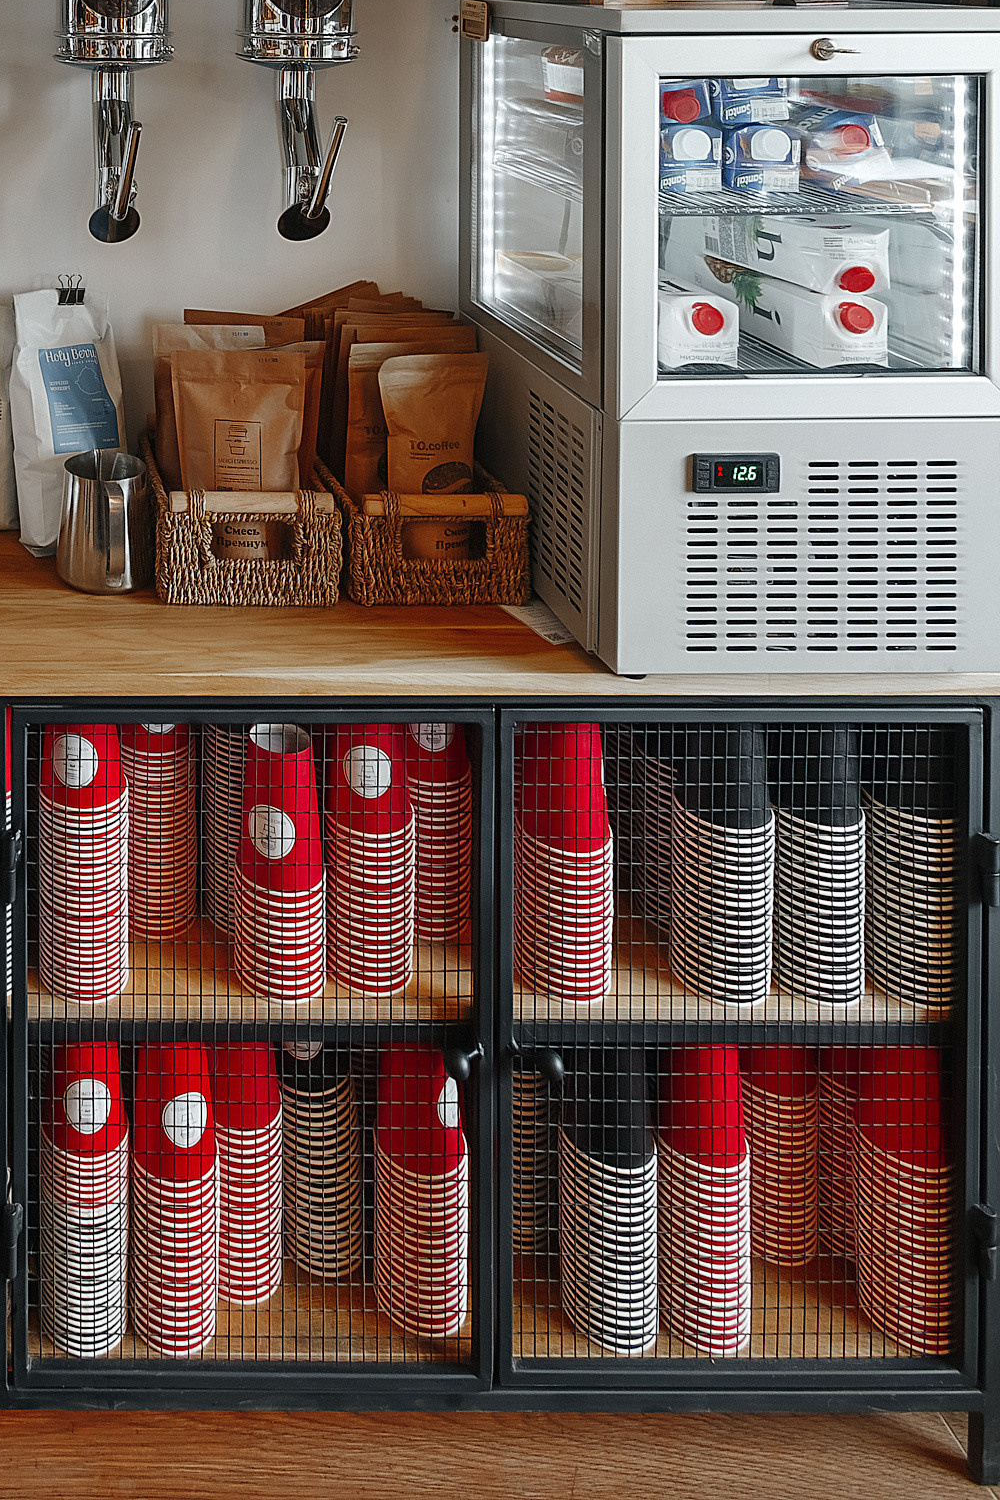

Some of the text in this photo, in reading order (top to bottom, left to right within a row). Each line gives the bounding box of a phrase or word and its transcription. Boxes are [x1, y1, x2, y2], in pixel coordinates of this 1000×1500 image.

[45, 348, 71, 368] Holy
[733, 466, 757, 481] 12.6
[224, 525, 260, 536] Смесь
